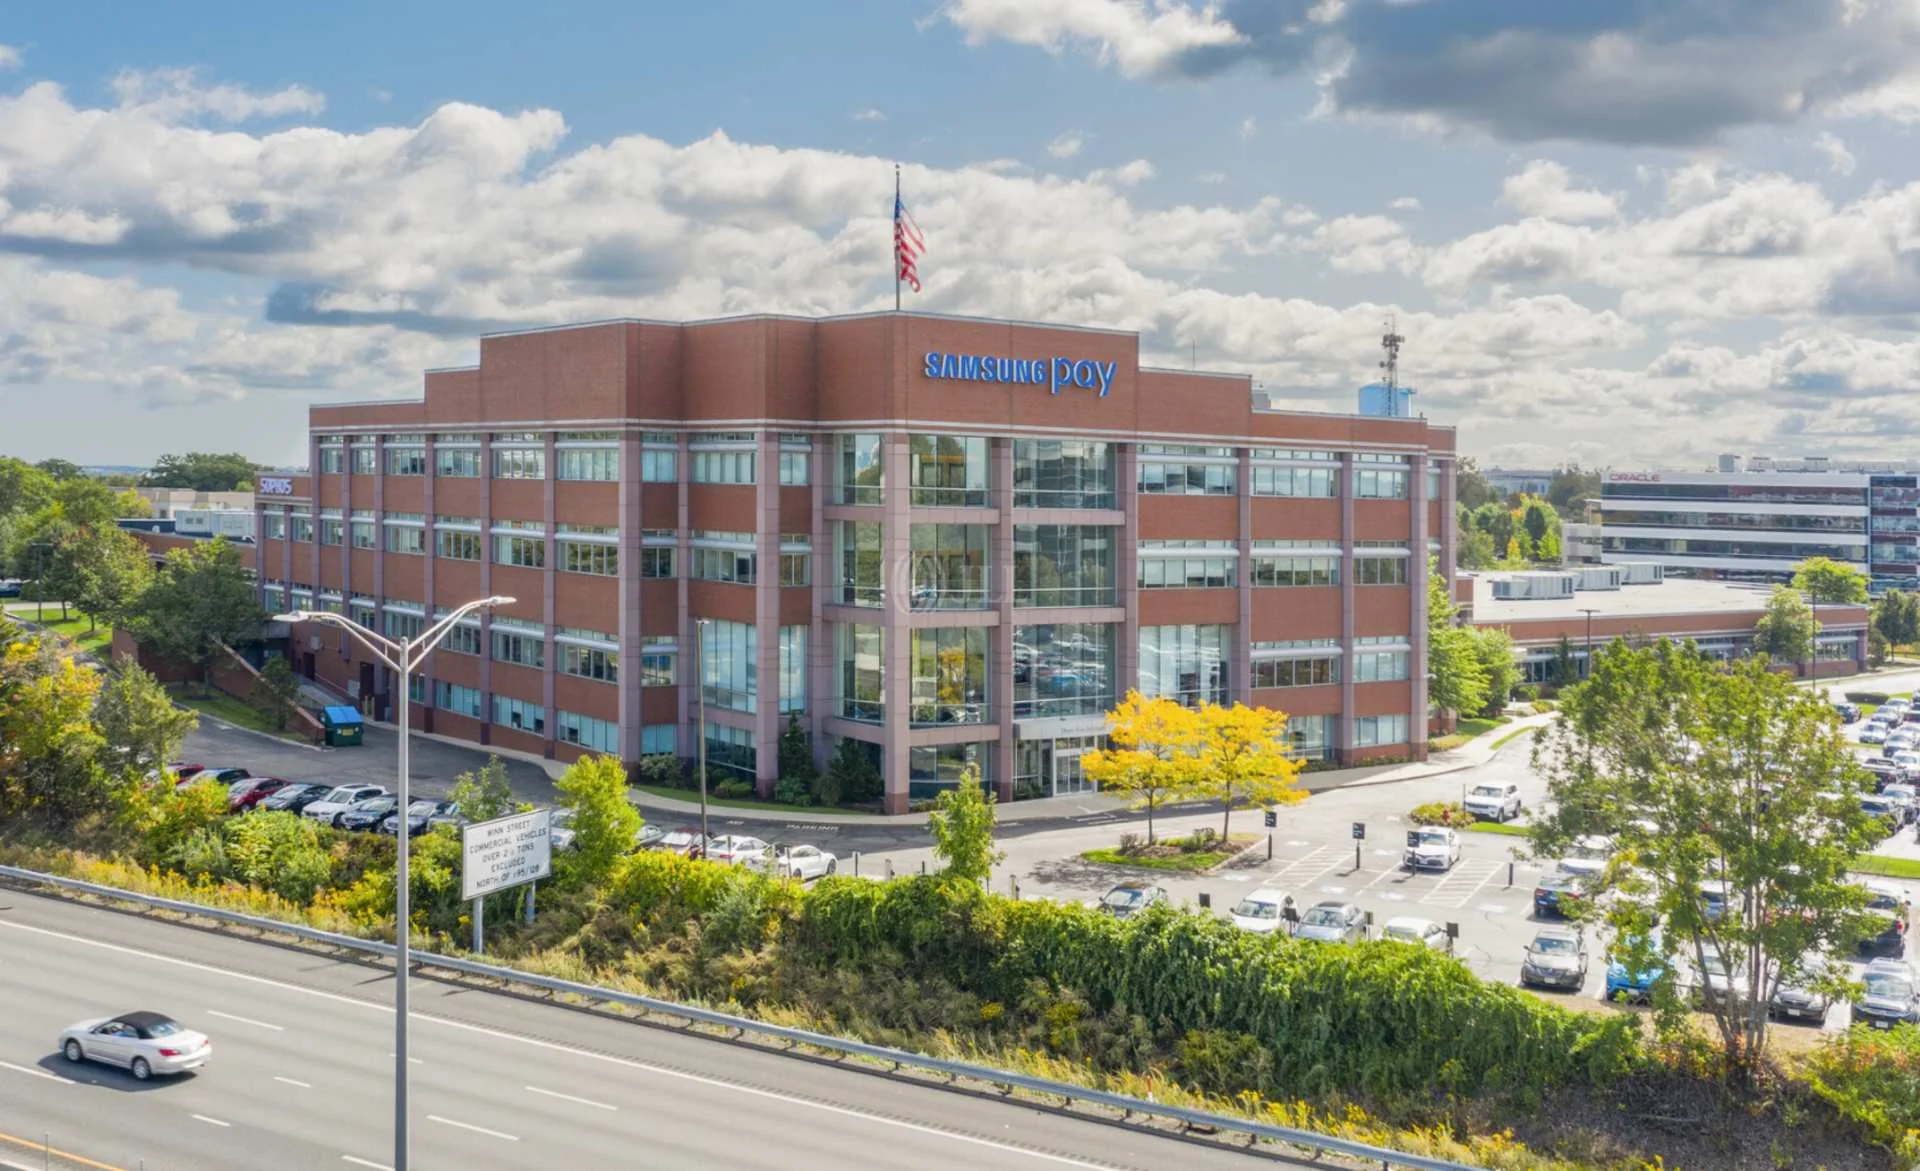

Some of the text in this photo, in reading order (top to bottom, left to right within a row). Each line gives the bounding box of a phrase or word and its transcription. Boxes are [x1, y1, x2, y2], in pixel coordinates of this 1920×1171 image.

[924, 351, 1117, 397] SAMSUNG pay
[1609, 472, 1661, 482] ORACLE
[517, 827, 546, 842] VEHICLES
